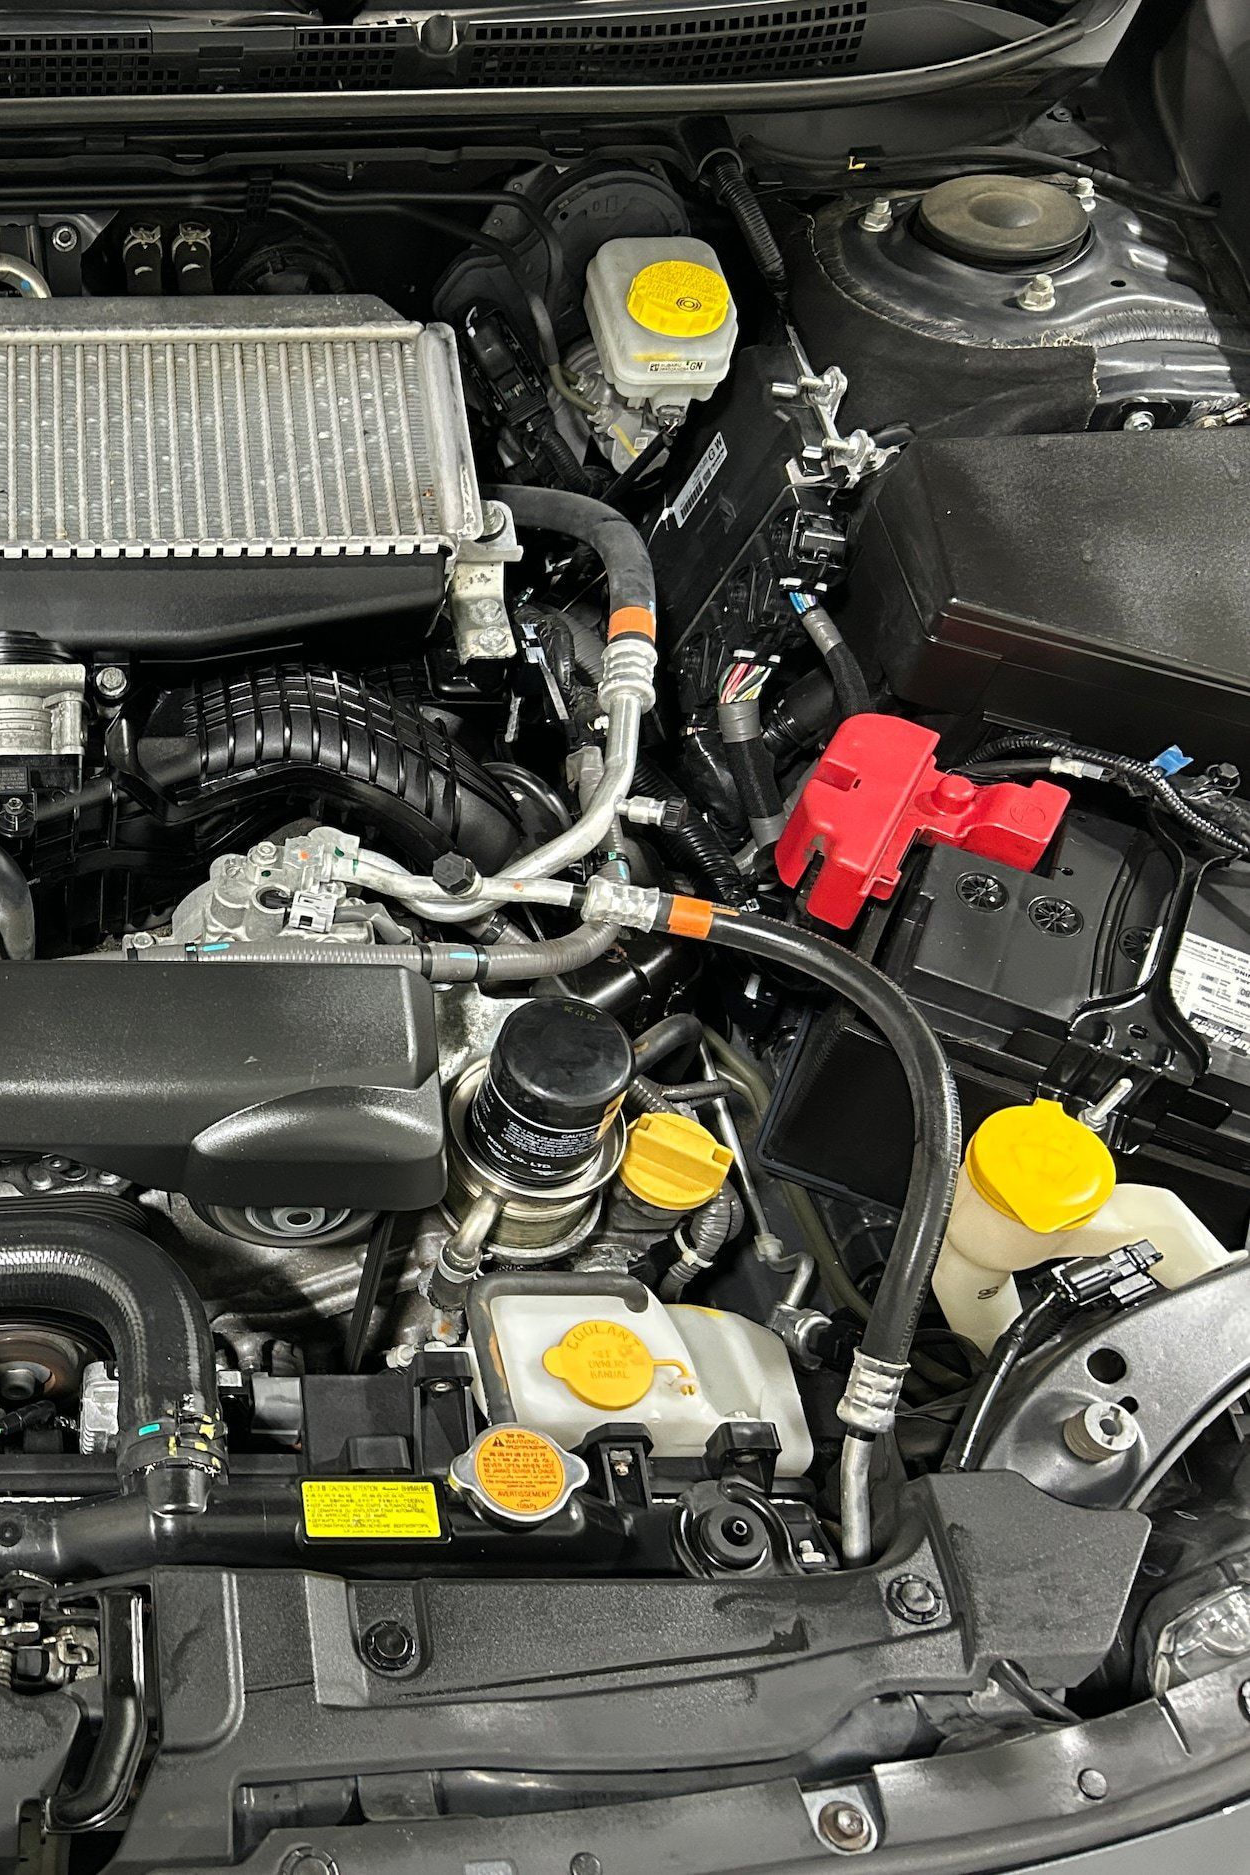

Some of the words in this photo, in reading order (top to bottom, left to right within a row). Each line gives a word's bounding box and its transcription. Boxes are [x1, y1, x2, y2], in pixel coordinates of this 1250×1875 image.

[689, 361, 703, 371] GN
[1194, 1018, 1242, 1039] PLATINUM
[561, 1129, 596, 1140] CAUTION
[566, 1323, 642, 1351] COOLANT
